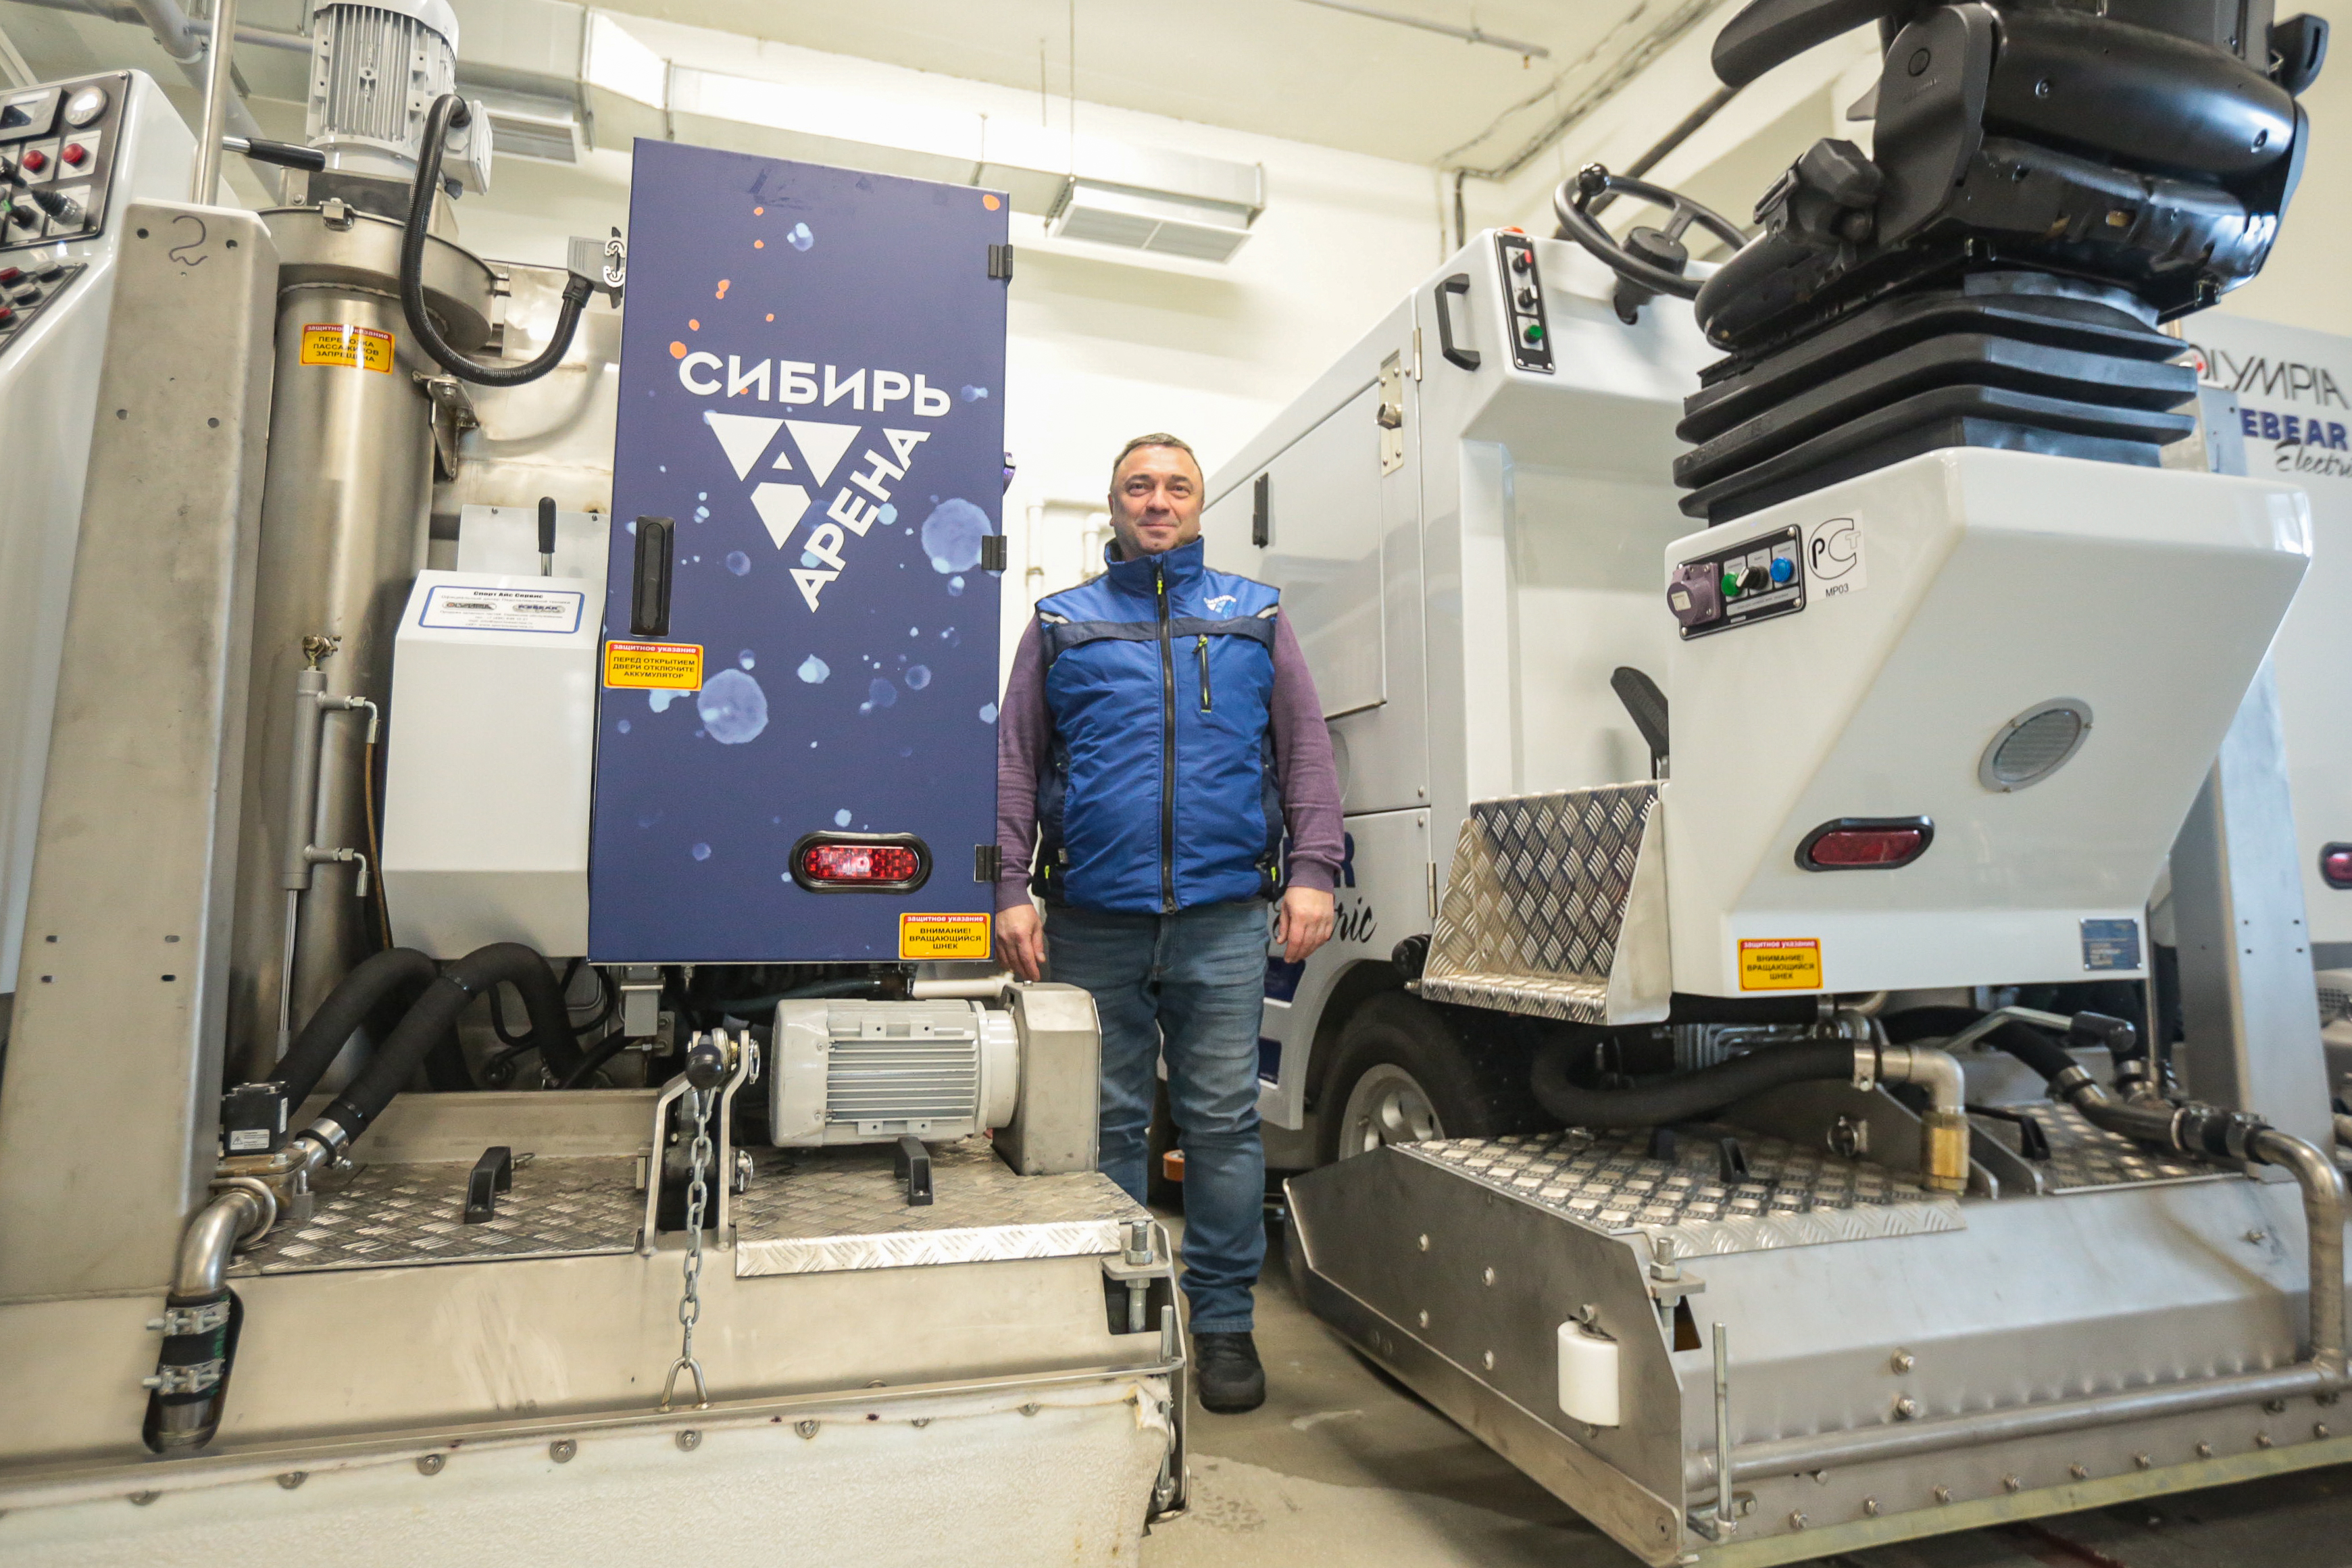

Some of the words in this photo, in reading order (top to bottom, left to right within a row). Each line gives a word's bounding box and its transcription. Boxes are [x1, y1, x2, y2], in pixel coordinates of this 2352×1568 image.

[679, 351, 951, 418] СИБИРЬ
[789, 428, 932, 613] АРЕНА
[614, 644, 655, 652] защитное
[643, 657, 695, 665] ОТКРЫТИЕМ
[909, 934, 981, 942] ВРАЩАЮЩИЙСЯ
